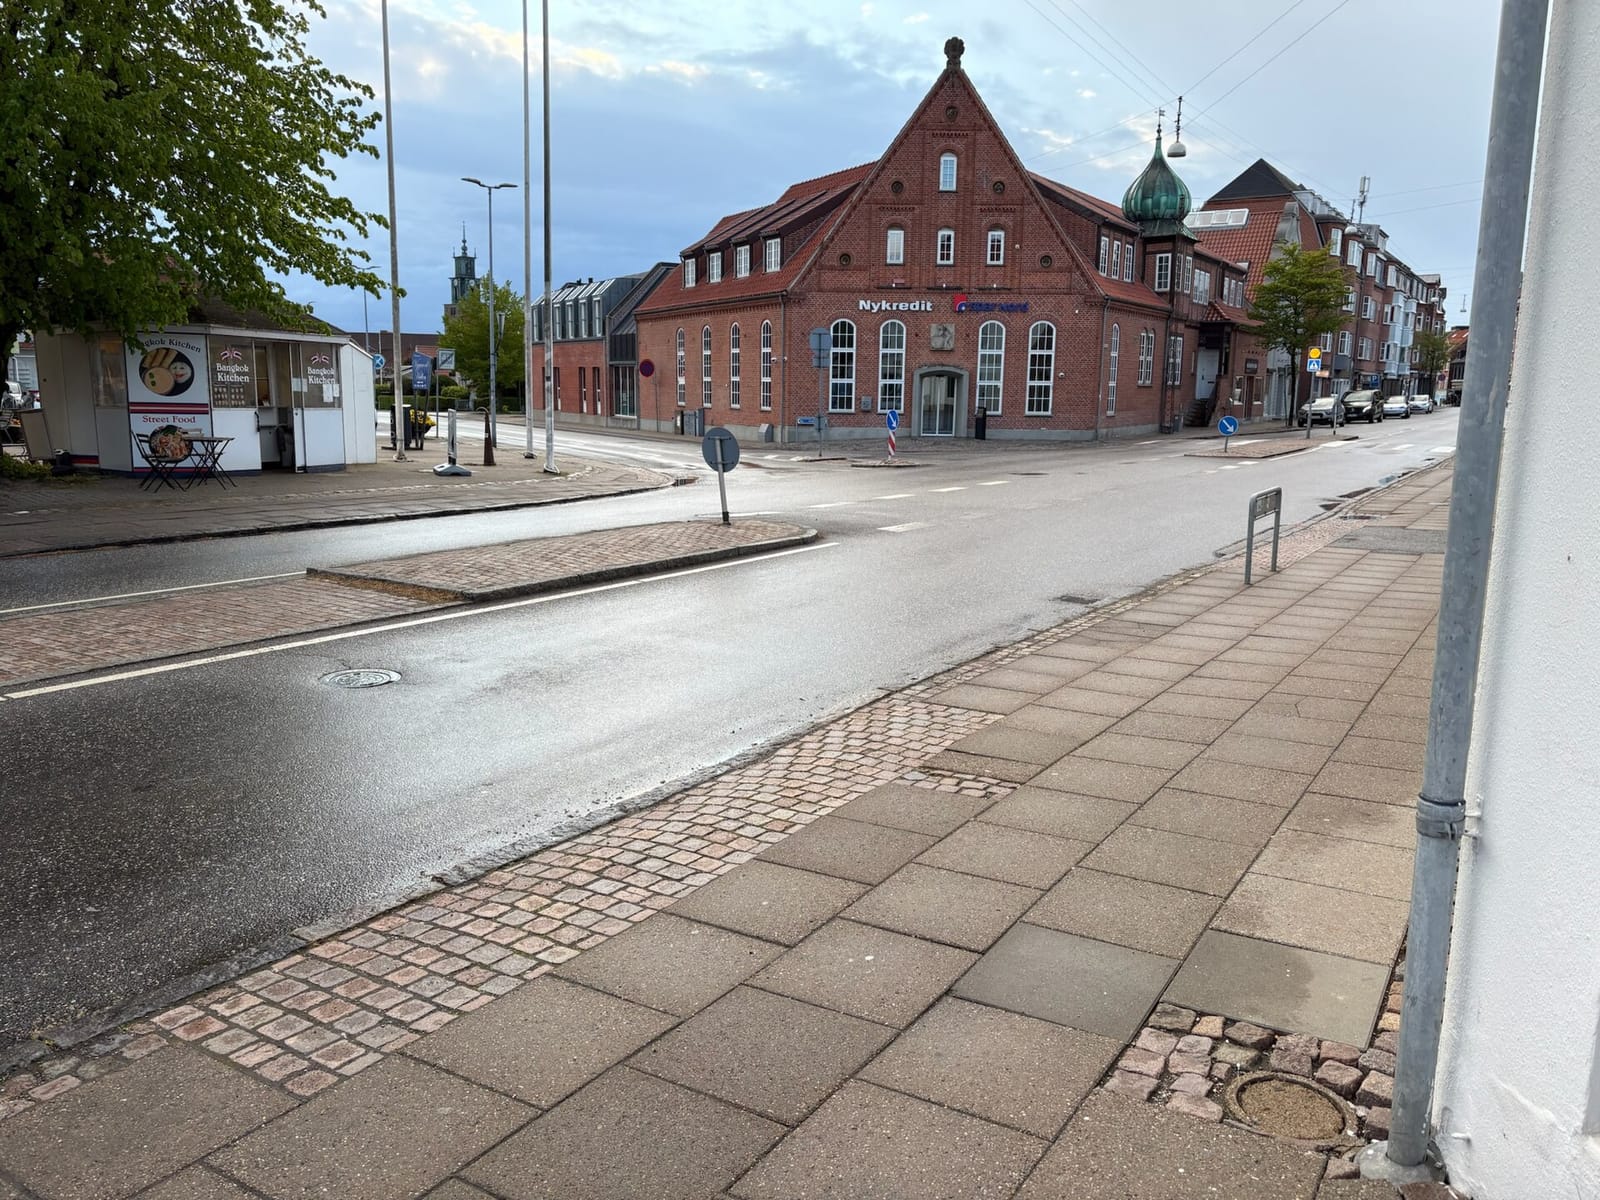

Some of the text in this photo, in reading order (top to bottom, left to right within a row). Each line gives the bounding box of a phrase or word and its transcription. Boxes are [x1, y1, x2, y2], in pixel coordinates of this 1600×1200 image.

[859, 299, 933, 313] Nykredit
[168, 338, 201, 353] Kitchen
[215, 362, 250, 374] Bangkok
[307, 366, 335, 377] Bangkok
[217, 373, 250, 383] Kitchen
[308, 375, 336, 385] Kitchen
[142, 415, 196, 424] Street Food
